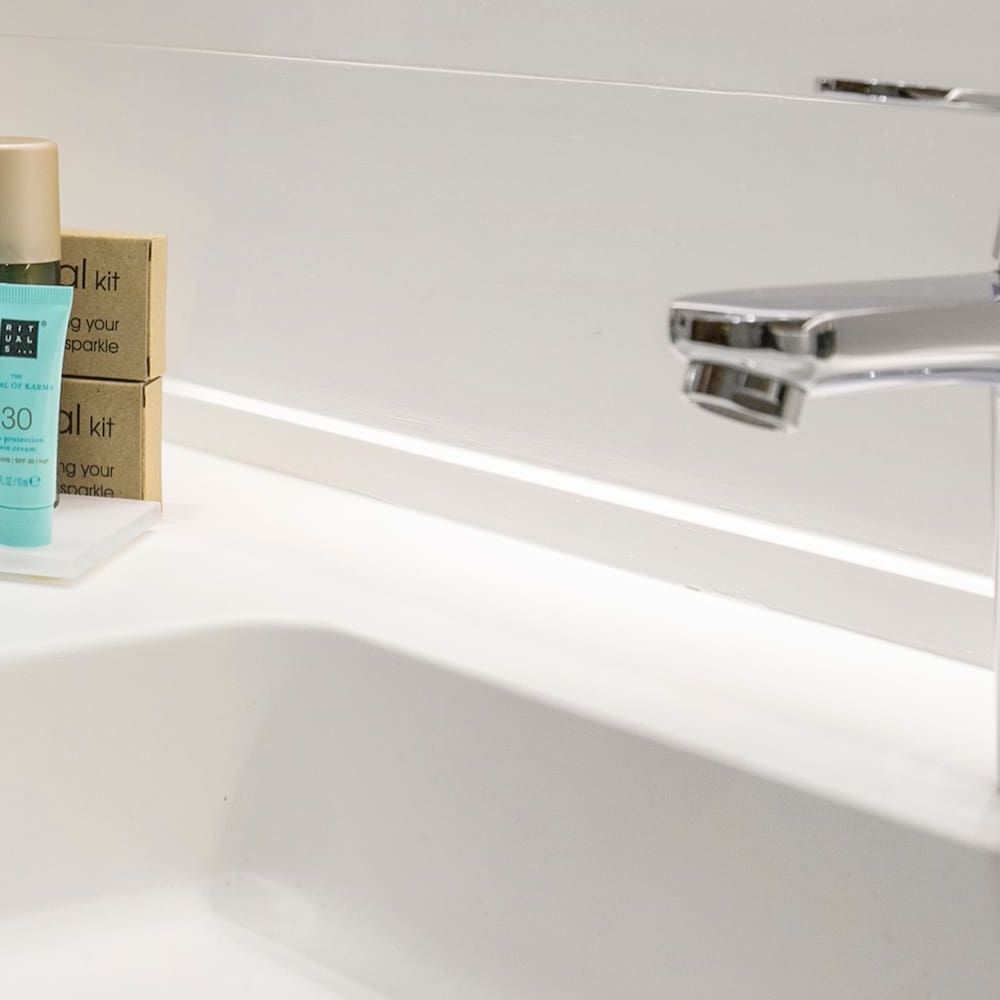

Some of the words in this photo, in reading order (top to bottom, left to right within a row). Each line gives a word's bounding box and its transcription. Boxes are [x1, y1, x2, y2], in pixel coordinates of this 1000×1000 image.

[95, 271, 120, 292] kit
[86, 318, 120, 332] your
[64, 337, 120, 354] sparkle
[1, 406, 32, 430] 30
[90, 416, 115, 438] kit
[80, 464, 114, 478] your
